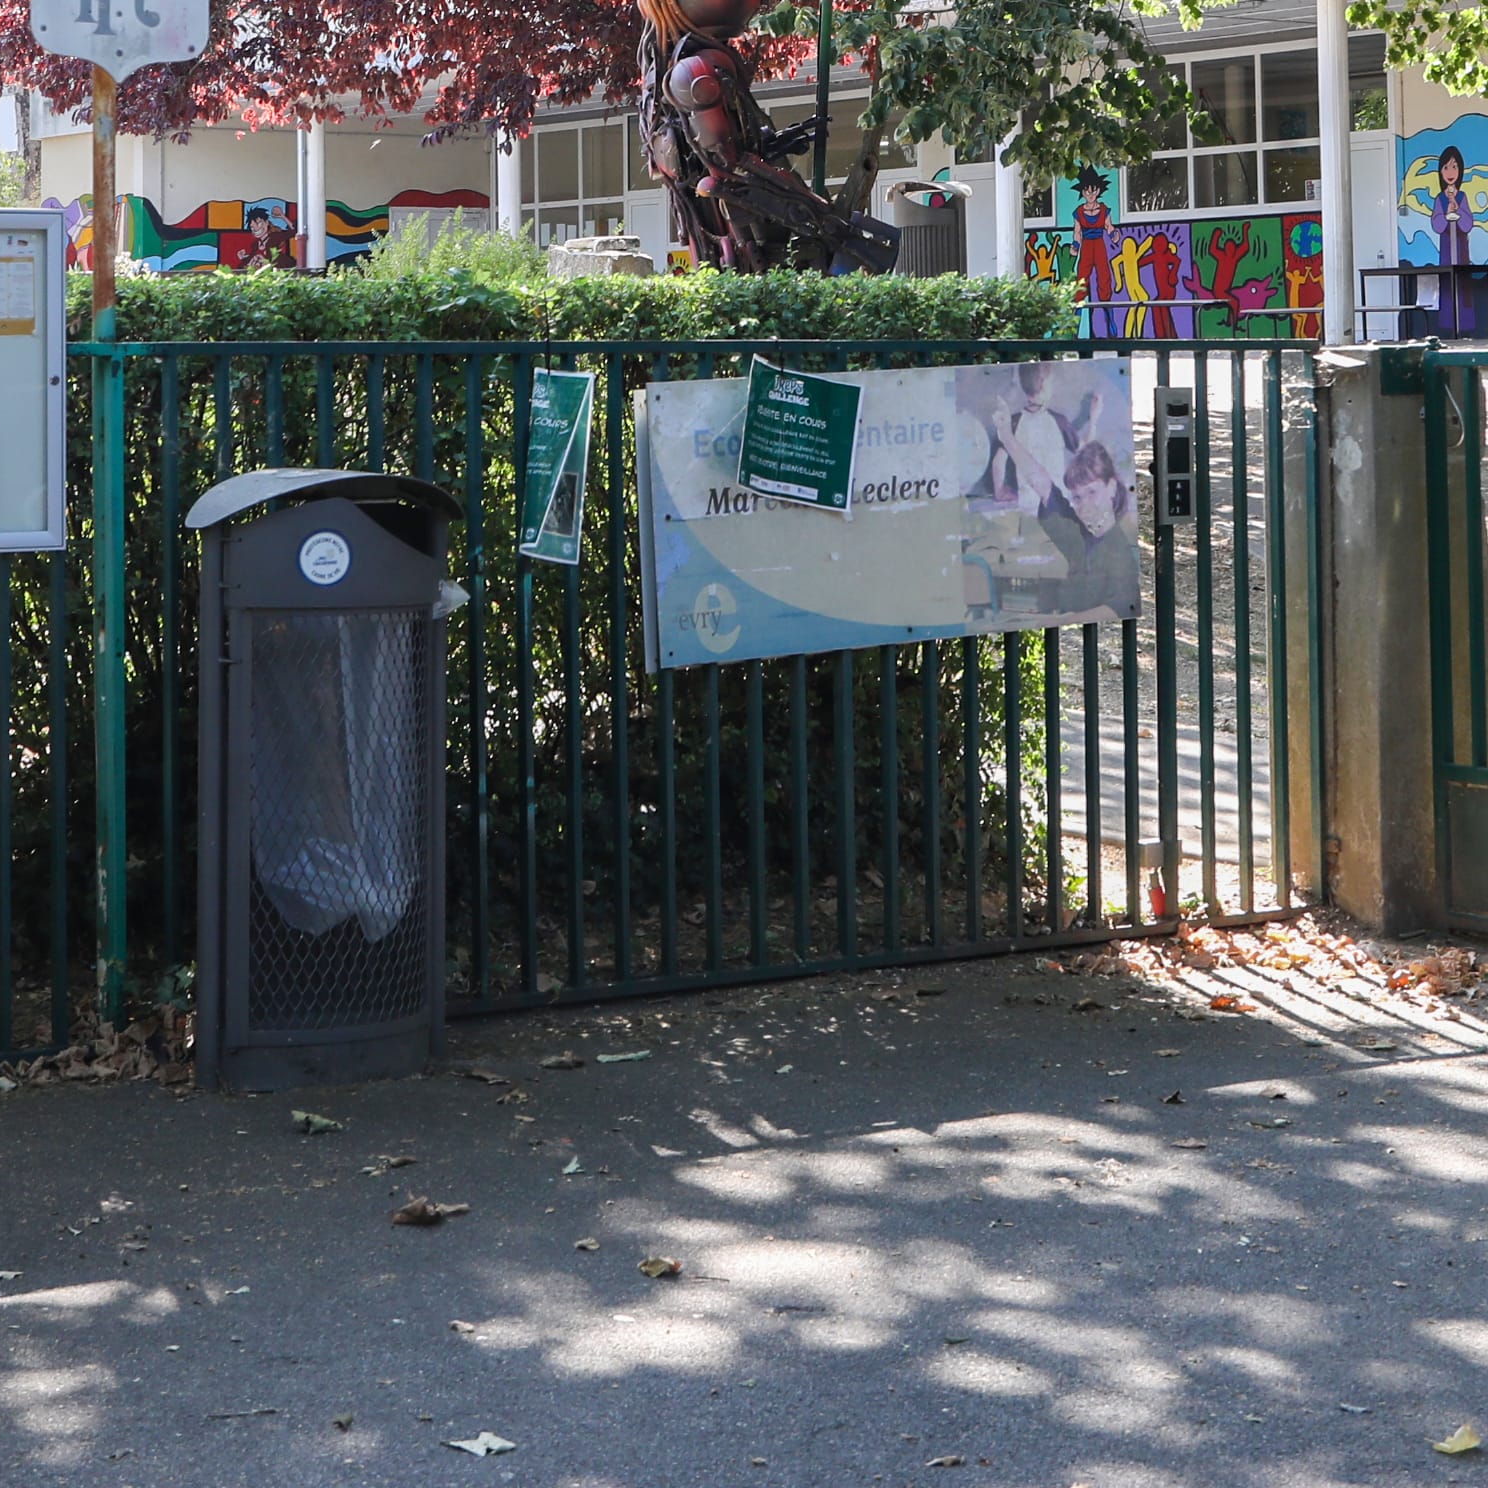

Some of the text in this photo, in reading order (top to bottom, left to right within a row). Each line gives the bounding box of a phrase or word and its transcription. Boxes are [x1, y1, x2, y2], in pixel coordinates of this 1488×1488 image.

[783, 412, 797, 424] EN
[798, 416, 827, 430] COURS
[694, 428, 741, 458] Eco
[857, 417, 945, 448] entaire
